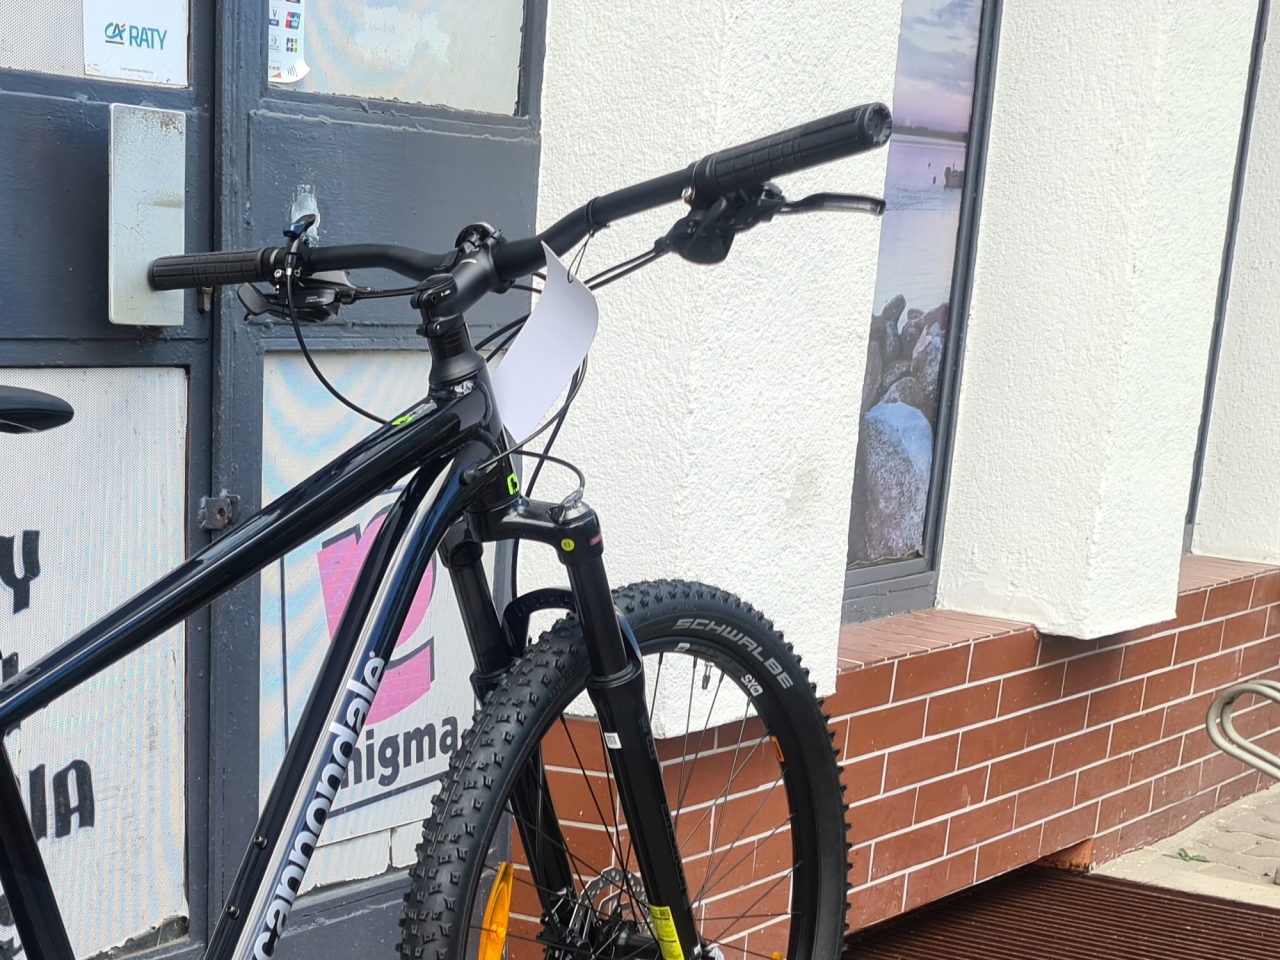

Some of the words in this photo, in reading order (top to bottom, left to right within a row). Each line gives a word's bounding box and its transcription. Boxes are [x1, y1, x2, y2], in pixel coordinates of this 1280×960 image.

[129, 25, 167, 50] RATY
[673, 618, 794, 690] SCHWALBE
[339, 716, 459, 789] nigma
